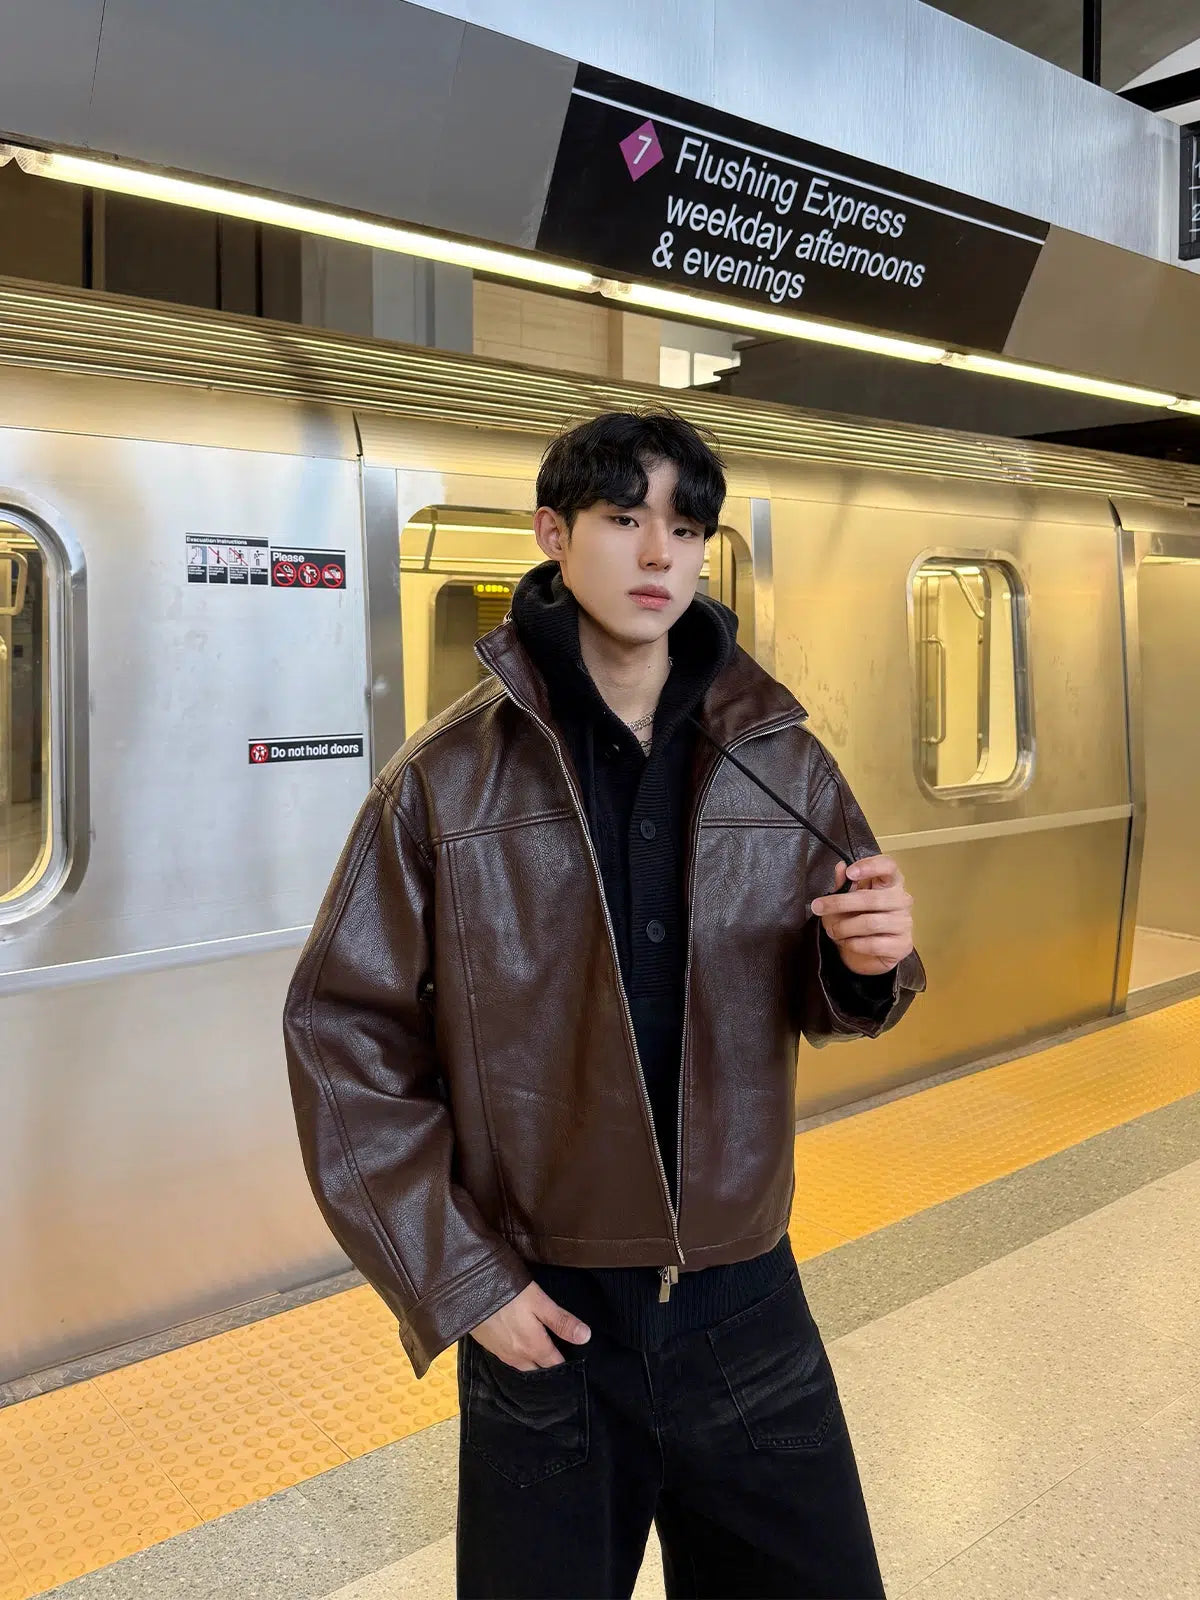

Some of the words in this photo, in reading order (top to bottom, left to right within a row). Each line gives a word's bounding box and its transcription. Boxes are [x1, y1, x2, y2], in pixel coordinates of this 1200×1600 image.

[632, 134, 652, 165] 7
[675, 135, 799, 215] Flushing
[802, 177, 906, 238] Express
[666, 195, 793, 261] weekday
[795, 228, 925, 288] afternoons
[651, 230, 674, 270] &
[682, 247, 806, 303] evenings
[186, 536, 217, 544] Evacuation
[272, 552, 305, 563] Please
[271, 746, 286, 758] Do
[288, 745, 305, 757] not
[306, 744, 328, 756] hold
[330, 743, 359, 754] doors
